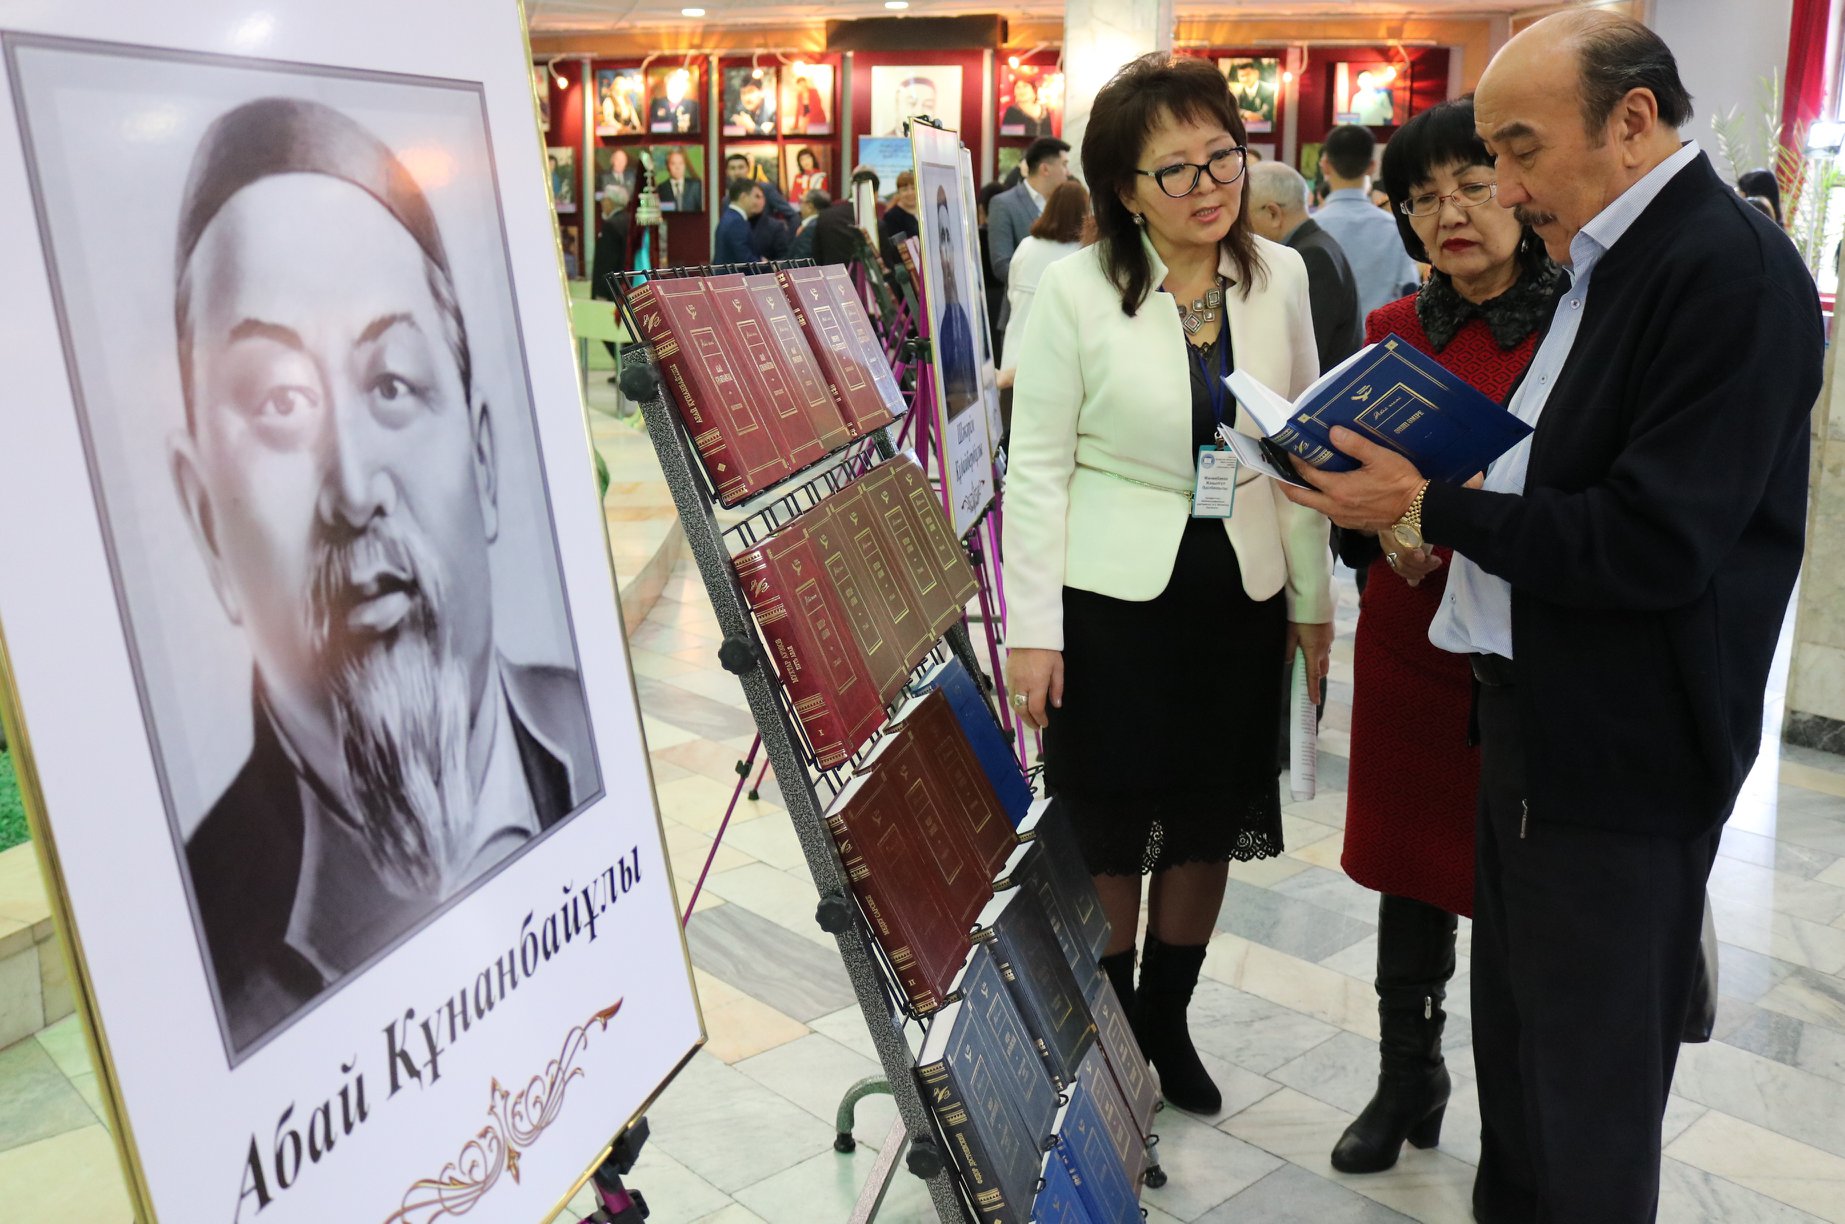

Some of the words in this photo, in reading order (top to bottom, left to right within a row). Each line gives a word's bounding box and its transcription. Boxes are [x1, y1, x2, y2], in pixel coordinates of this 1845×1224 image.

[690, 407, 703, 423] АБАЙ
[785, 661, 799, 684] МУХТАР
[233, 1053, 370, 1224] Абай
[381, 845, 643, 1101] Құнанбайұлы
